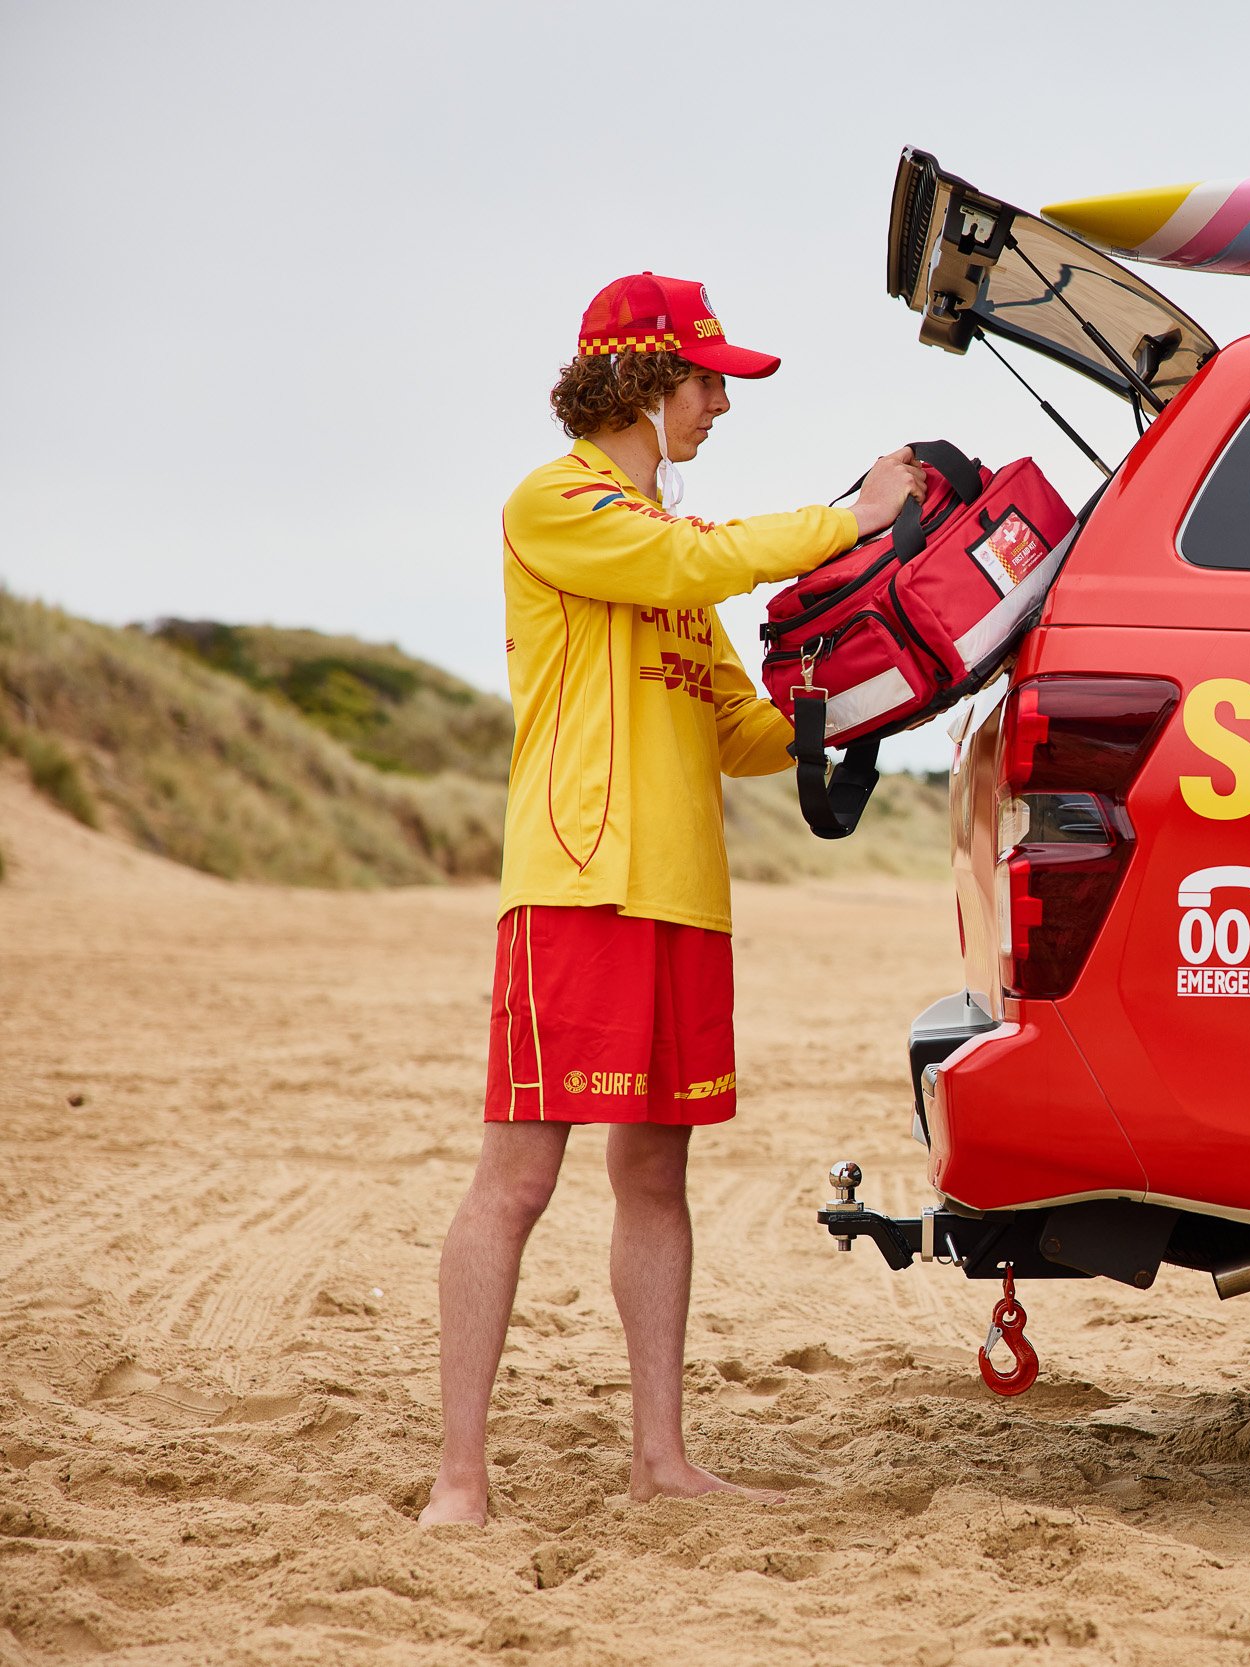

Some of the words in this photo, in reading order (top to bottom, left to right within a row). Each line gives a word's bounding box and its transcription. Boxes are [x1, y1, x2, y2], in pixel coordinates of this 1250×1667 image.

[1011, 552, 1024, 566] FIRST
[1022, 546, 1031, 557] AID
[1028, 540, 1036, 550] KIT
[591, 1072, 633, 1096] SURF
